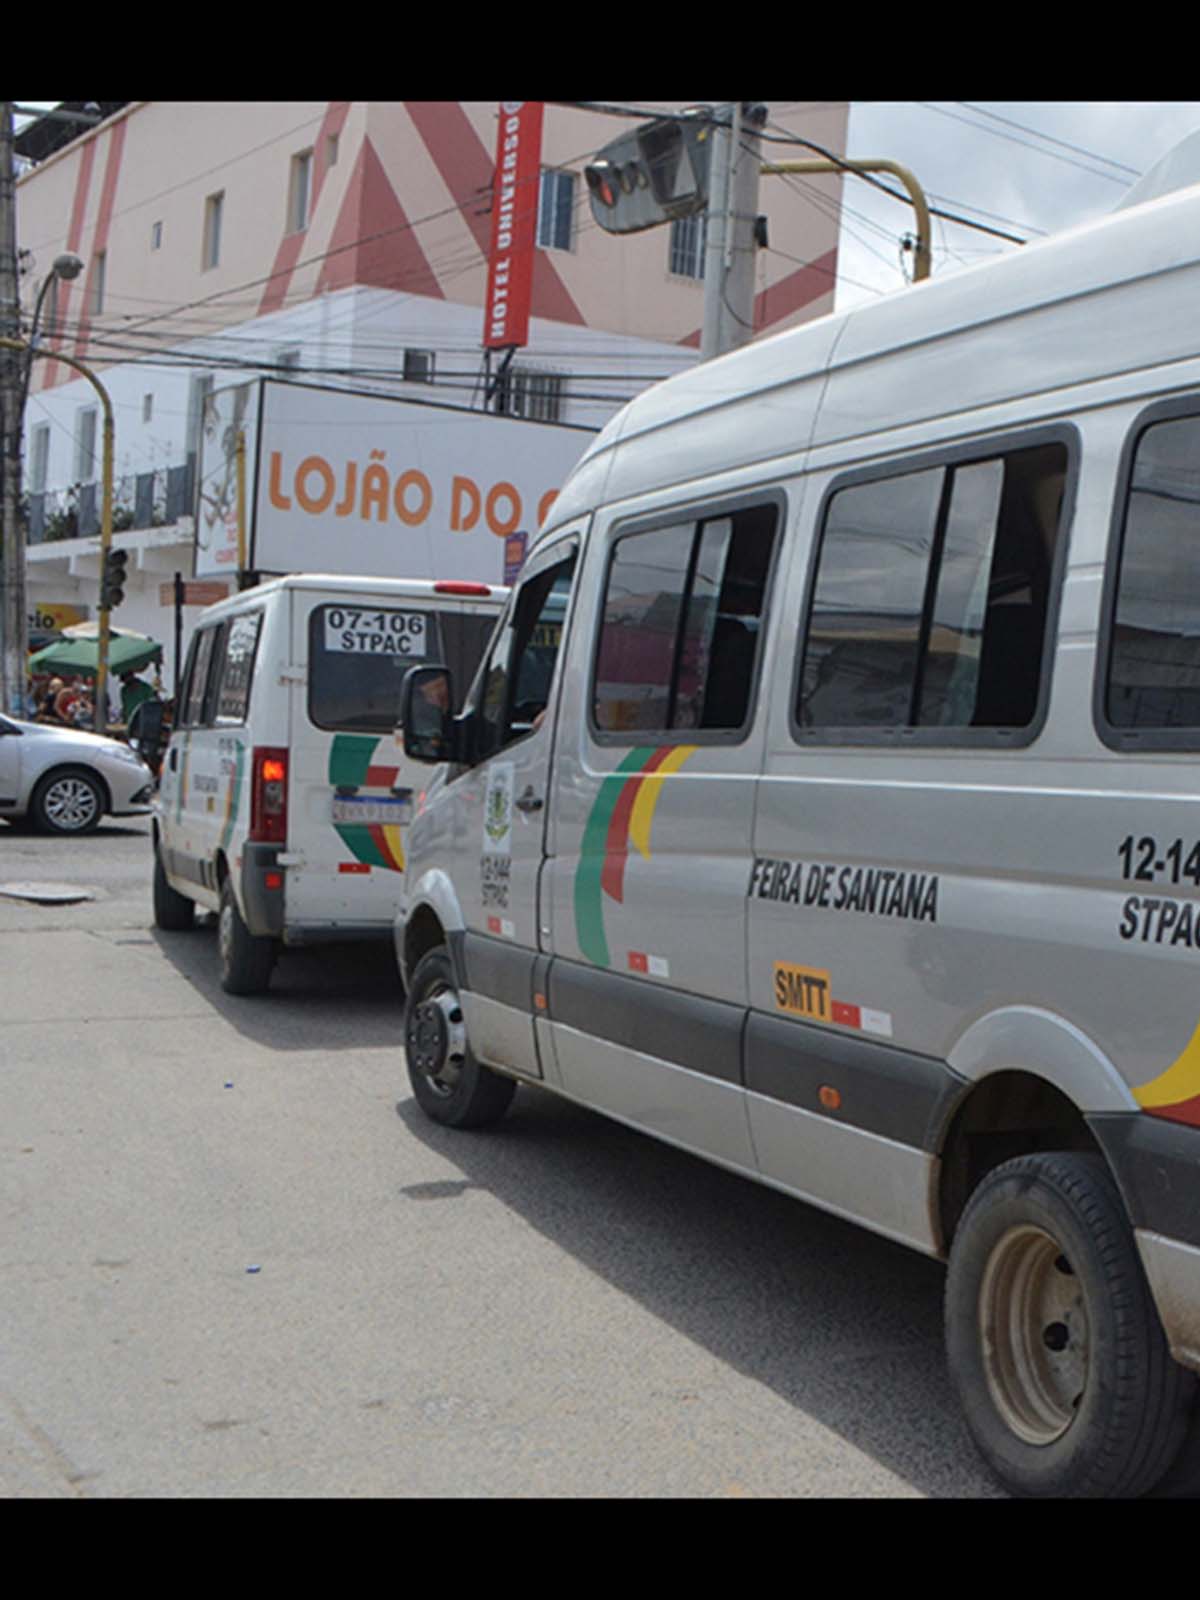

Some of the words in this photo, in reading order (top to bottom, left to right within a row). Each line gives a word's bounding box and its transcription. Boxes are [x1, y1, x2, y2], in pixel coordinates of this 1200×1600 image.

[497, 116, 520, 248] UNIVERSO
[491, 257, 510, 338] HOTEL
[268, 448, 433, 527] LOJÃO
[449, 475, 523, 538] DO
[328, 609, 423, 634] 07-106
[341, 630, 411, 653] STPAC
[748, 857, 802, 904] FEIRA
[804, 864, 836, 908] DE
[833, 866, 938, 922] SANTANA
[776, 968, 827, 1016] SMTT
